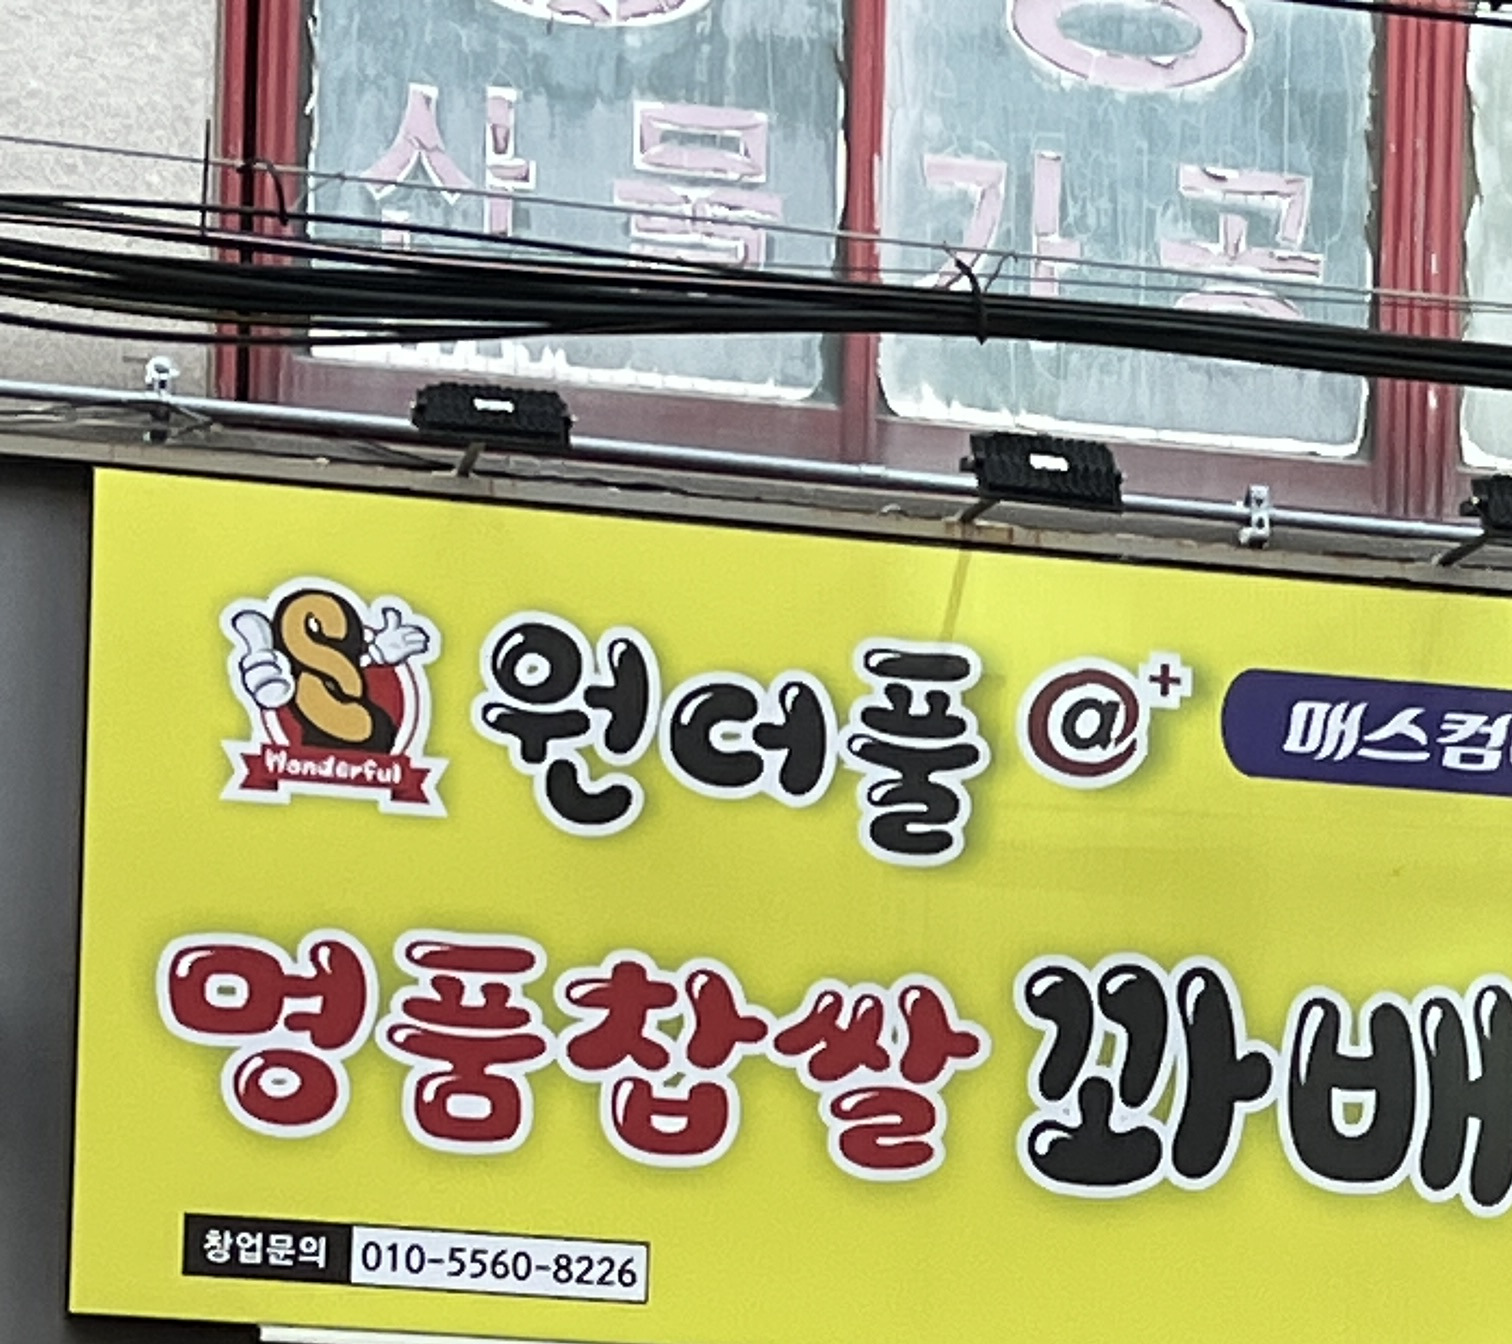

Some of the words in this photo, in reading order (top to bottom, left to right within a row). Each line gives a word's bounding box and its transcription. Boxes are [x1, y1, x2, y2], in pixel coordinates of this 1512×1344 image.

[264, 749, 402, 784] Wonderful
[482, 620, 984, 858] 원더풀
[165, 936, 984, 1172] 명품찹쌀
[202, 1229, 327, 1268] 창업문의
[361, 1241, 637, 1288] 010-5560-8226
